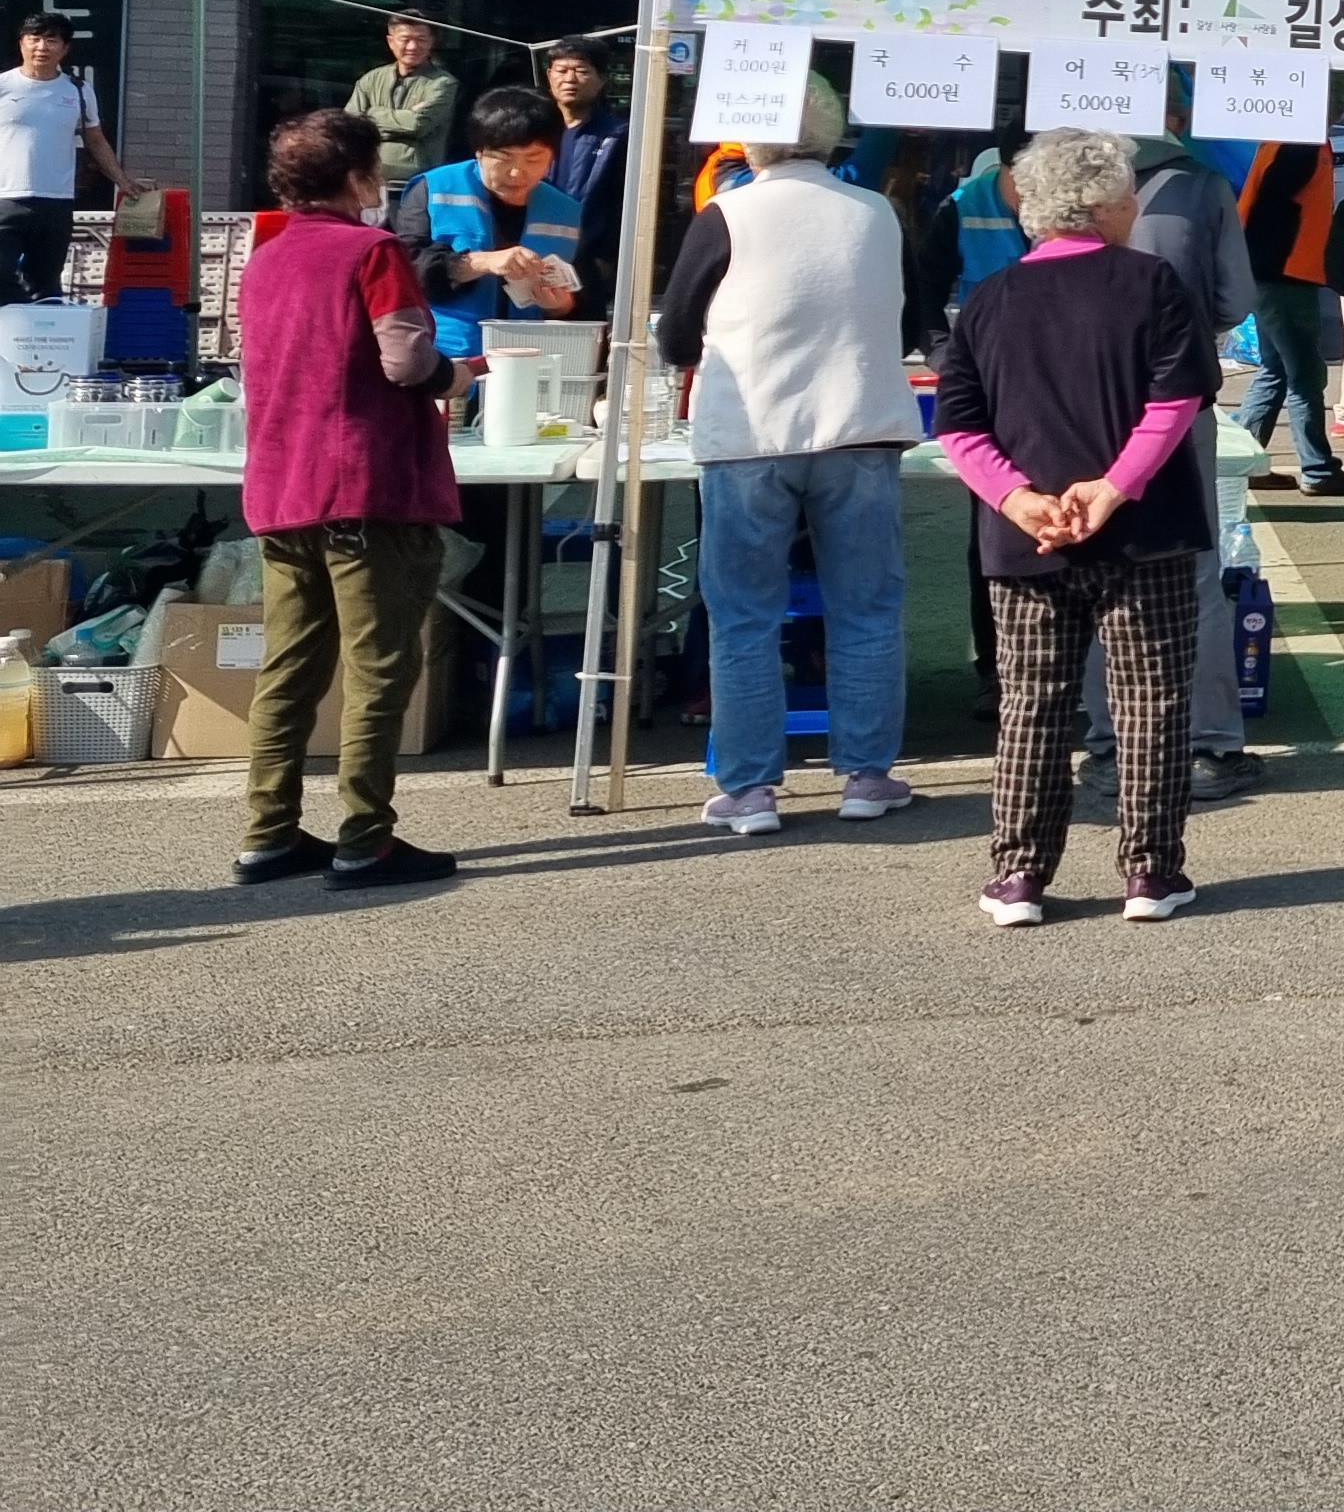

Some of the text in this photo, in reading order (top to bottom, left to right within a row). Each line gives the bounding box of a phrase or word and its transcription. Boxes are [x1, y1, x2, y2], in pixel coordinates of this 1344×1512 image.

[723, 58, 787, 74] 3,000원
[885, 81, 960, 103] 6,000원
[1059, 93, 1131, 115] 5,000원
[1225, 96, 1294, 118] 3,000원
[717, 111, 779, 127] 1,000원
